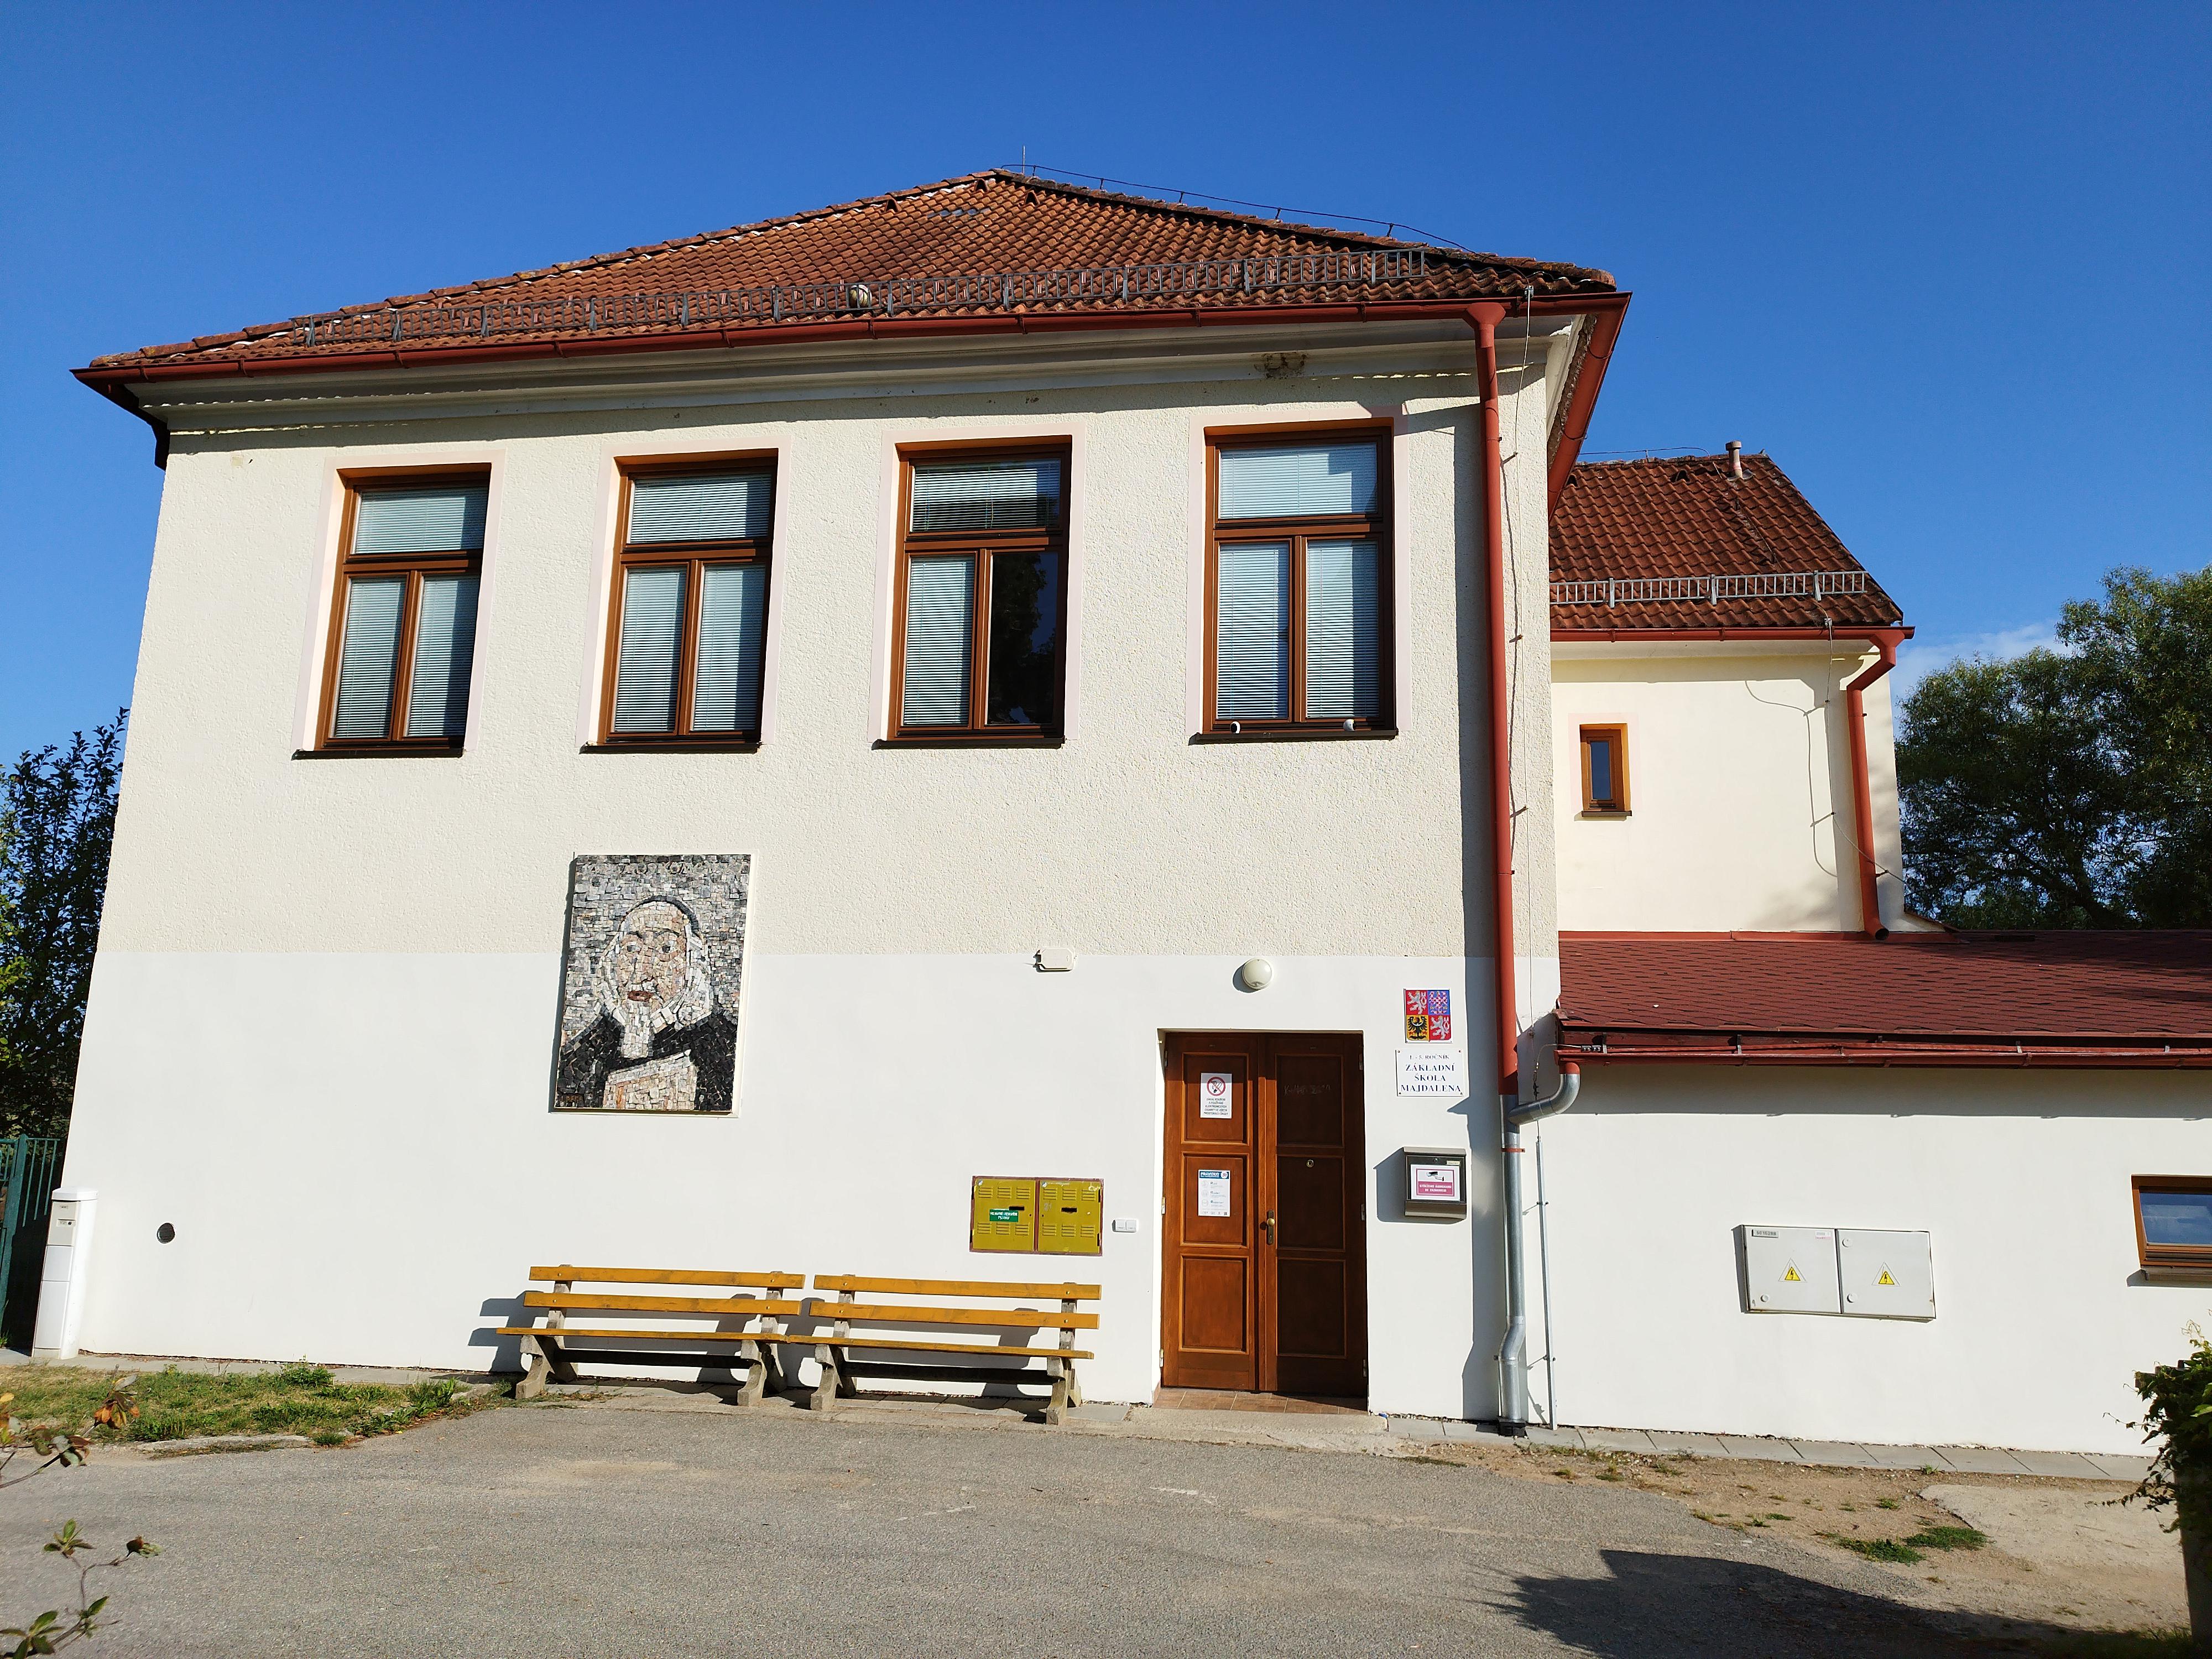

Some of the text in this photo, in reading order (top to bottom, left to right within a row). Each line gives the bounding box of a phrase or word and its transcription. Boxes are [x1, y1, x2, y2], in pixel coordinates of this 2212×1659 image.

[1405, 1062, 1455, 1071] ZÁKLADNÍ
[1415, 1073, 1446, 1082] ŠKOLA
[1401, 1084, 1461, 1093] MAJDALENA
